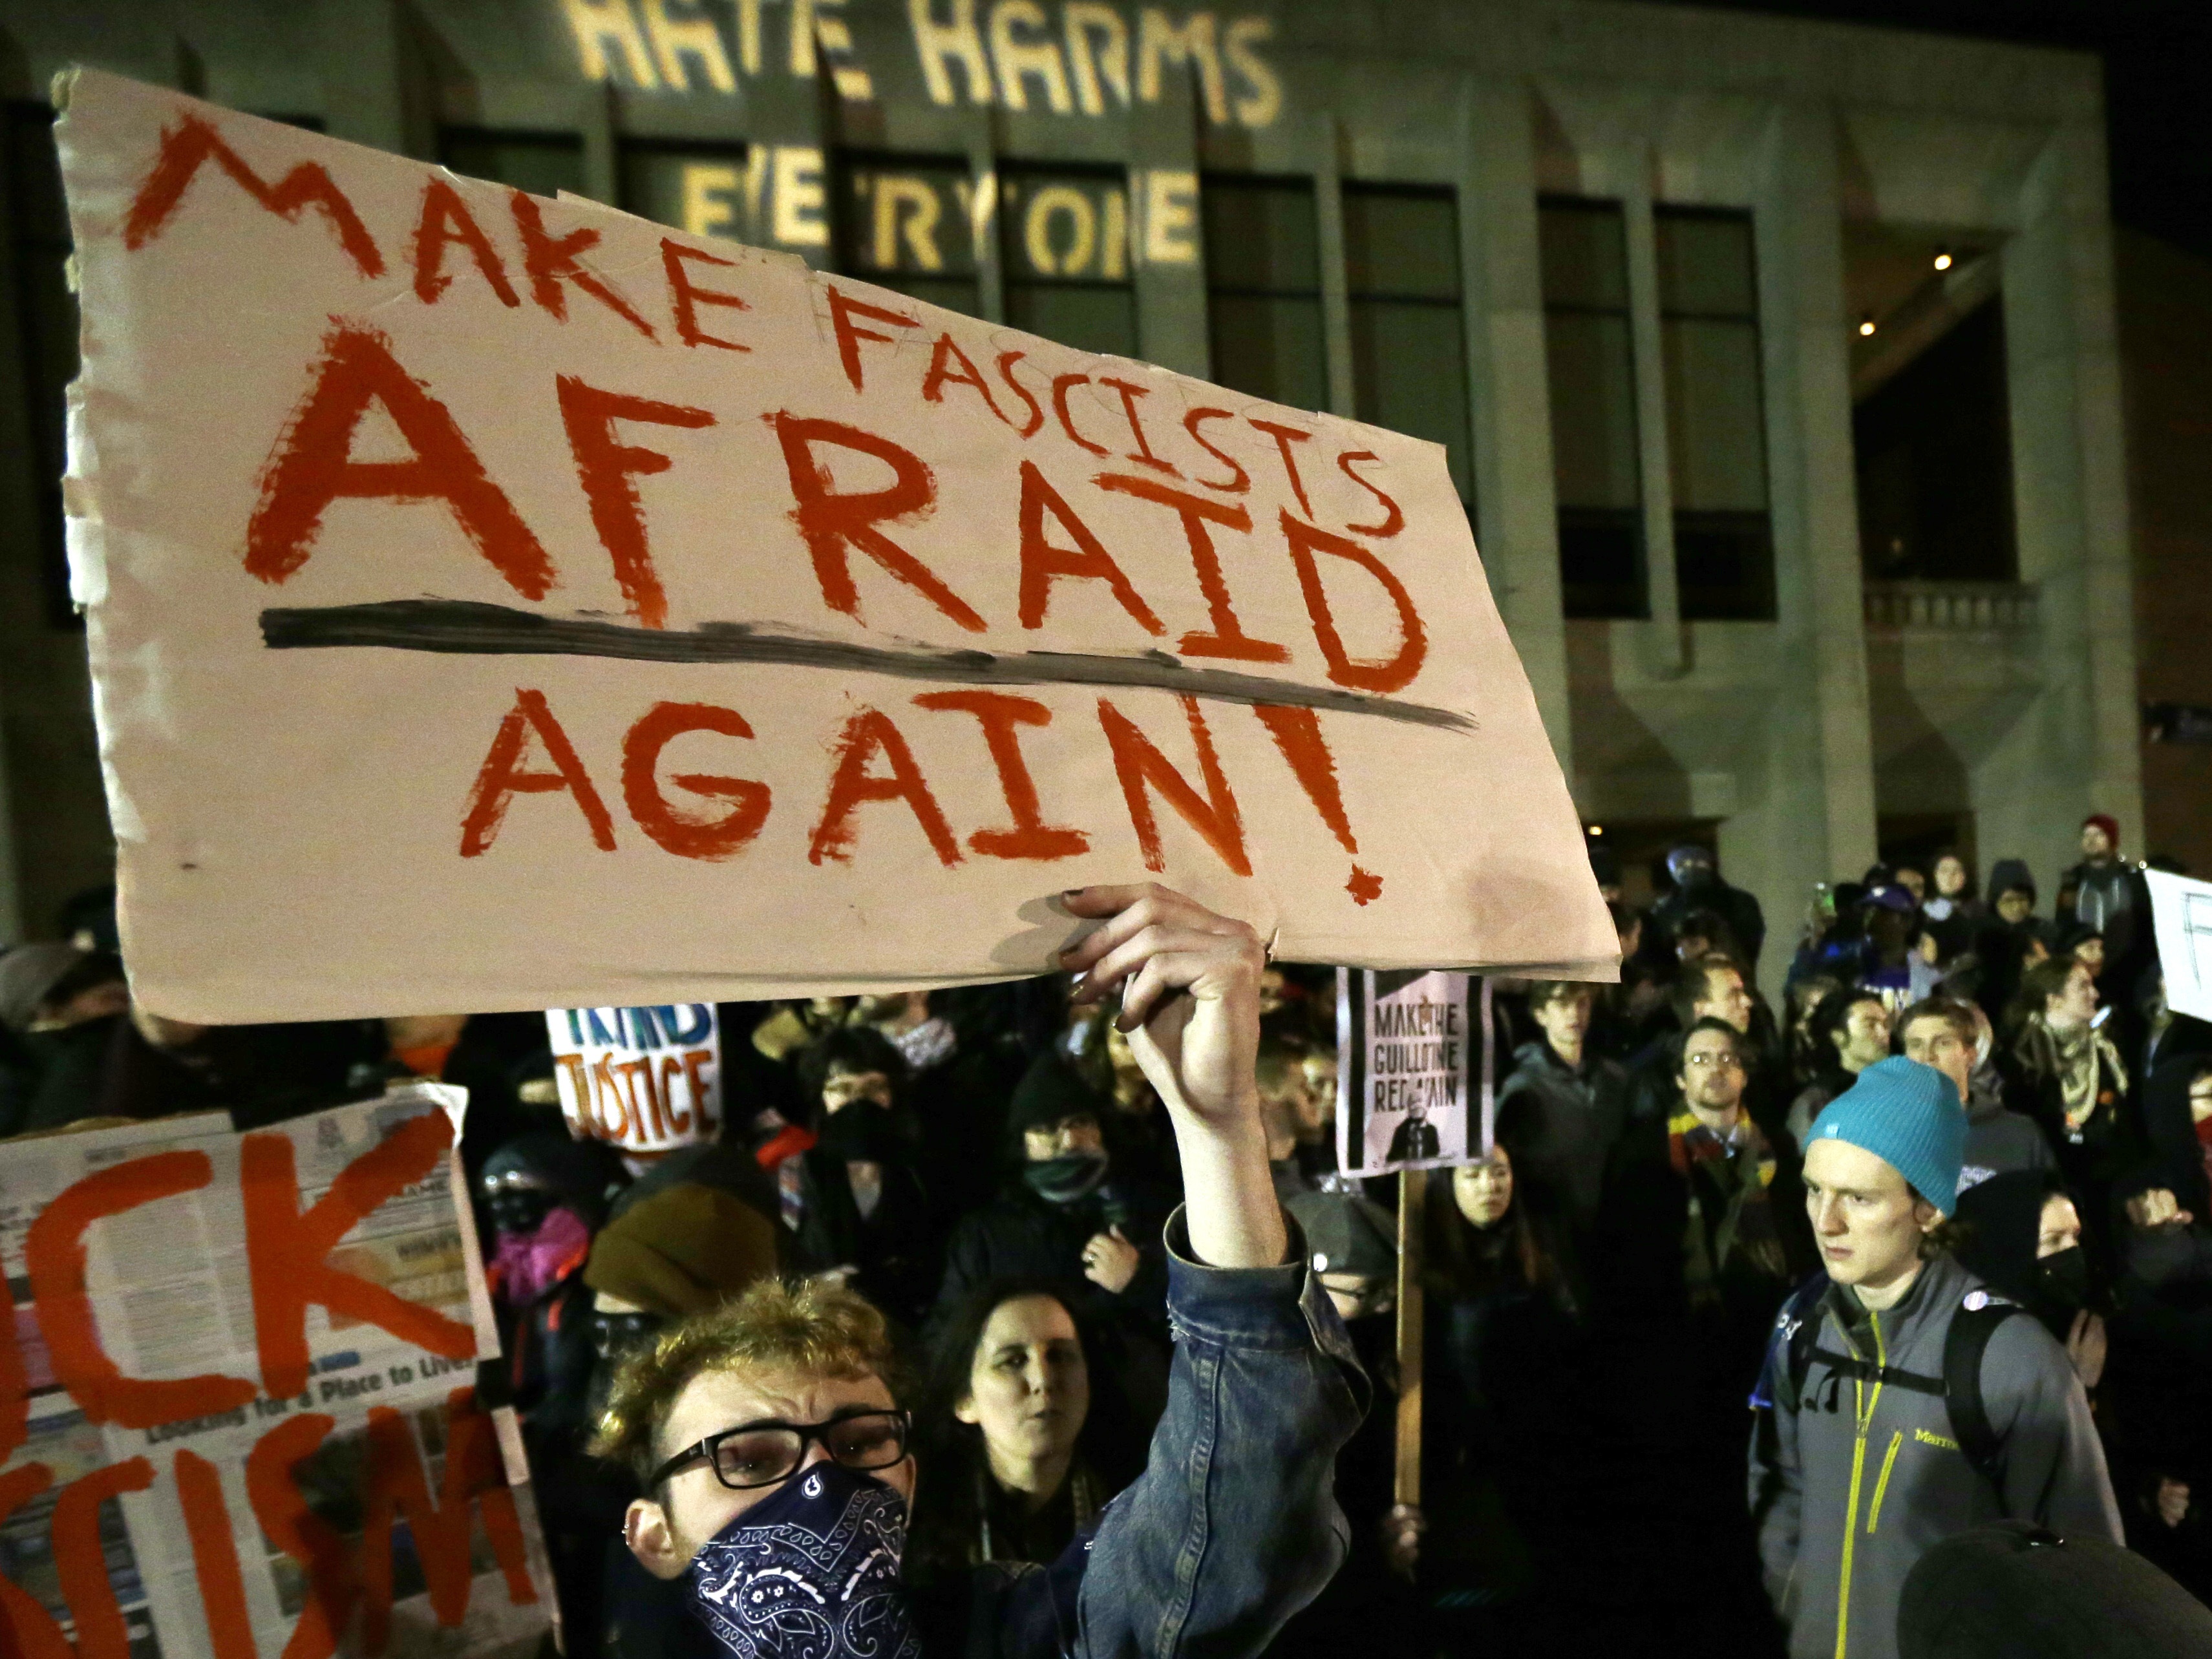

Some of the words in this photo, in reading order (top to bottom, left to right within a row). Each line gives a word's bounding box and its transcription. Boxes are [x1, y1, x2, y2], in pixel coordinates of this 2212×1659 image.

[910, 0, 1285, 127] HARMS
[124, 107, 751, 354] MAKE
[827, 284, 1405, 538] FASCISTS
[243, 314, 1429, 698] AFRAID
[460, 688, 1384, 907] AGAIN!
[555, 1050, 717, 1143] JUSTICE
[319, 1371, 383, 1402] Place
[388, 1365, 414, 1386] to
